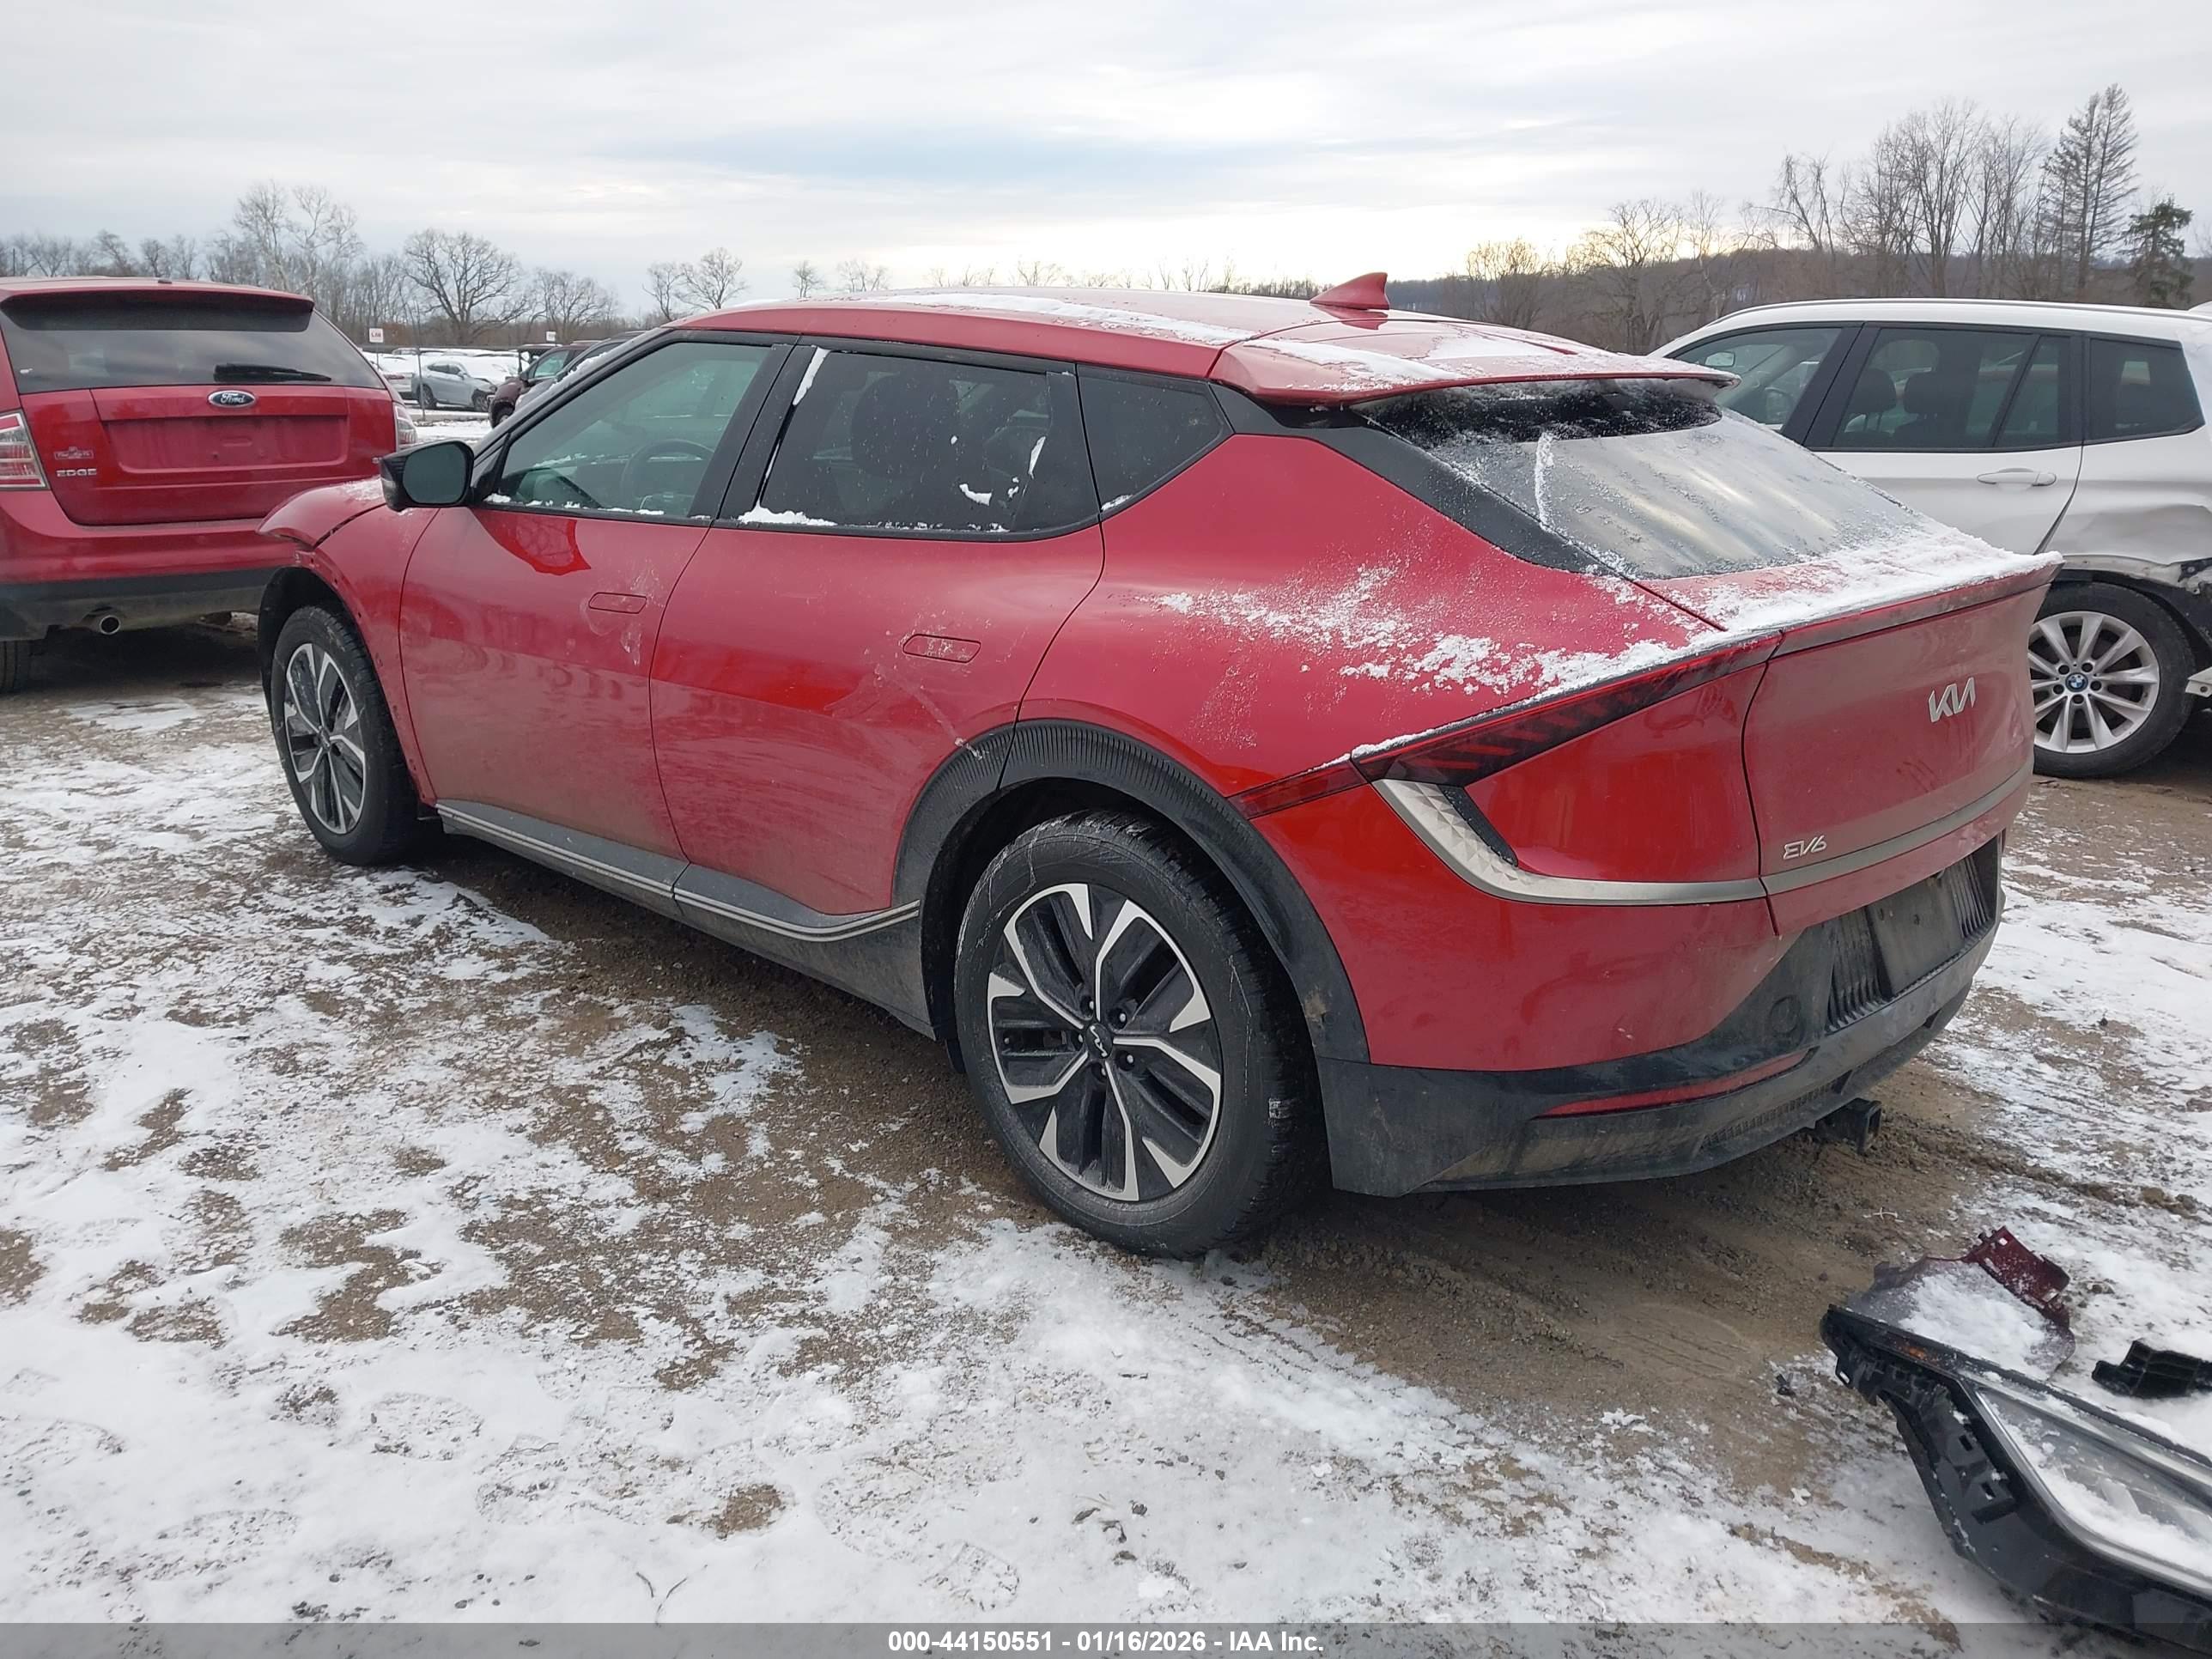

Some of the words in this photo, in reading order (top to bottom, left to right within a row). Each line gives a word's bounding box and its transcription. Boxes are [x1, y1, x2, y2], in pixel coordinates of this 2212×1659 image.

[220, 392, 246, 404] Ford
[57, 468, 97, 477] EDGE
[1927, 676, 1977, 723] KIA
[1783, 835, 1827, 860] EV6
